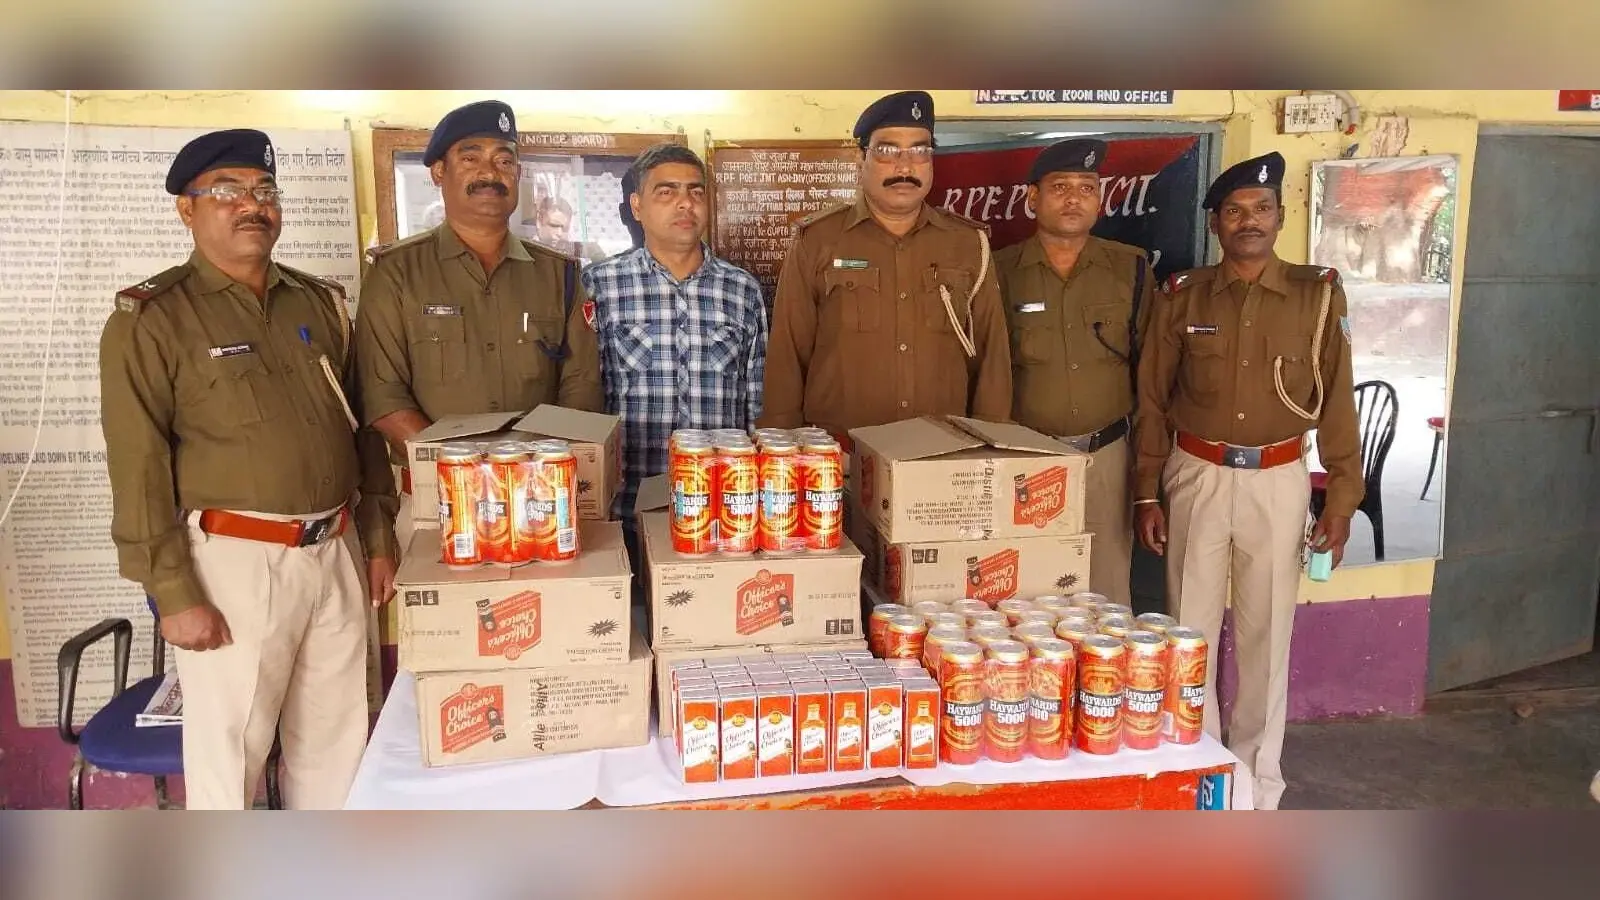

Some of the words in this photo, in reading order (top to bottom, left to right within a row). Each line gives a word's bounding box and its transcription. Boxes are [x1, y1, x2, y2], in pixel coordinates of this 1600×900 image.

[1062, 90, 1094, 101] ROOM
[1097, 90, 1120, 101] AND
[1124, 91, 1168, 102] OFFICE
[78, 451, 92, 463] THE
[740, 600, 775, 618] Choice
[1080, 691, 1122, 707] HAYWARDS
[989, 699, 1030, 714] HAYWARD
[1085, 704, 1115, 718] 5000
[1128, 700, 1158, 713] 5000
[955, 713, 982, 727] 5000
[997, 712, 1025, 724] 5000
